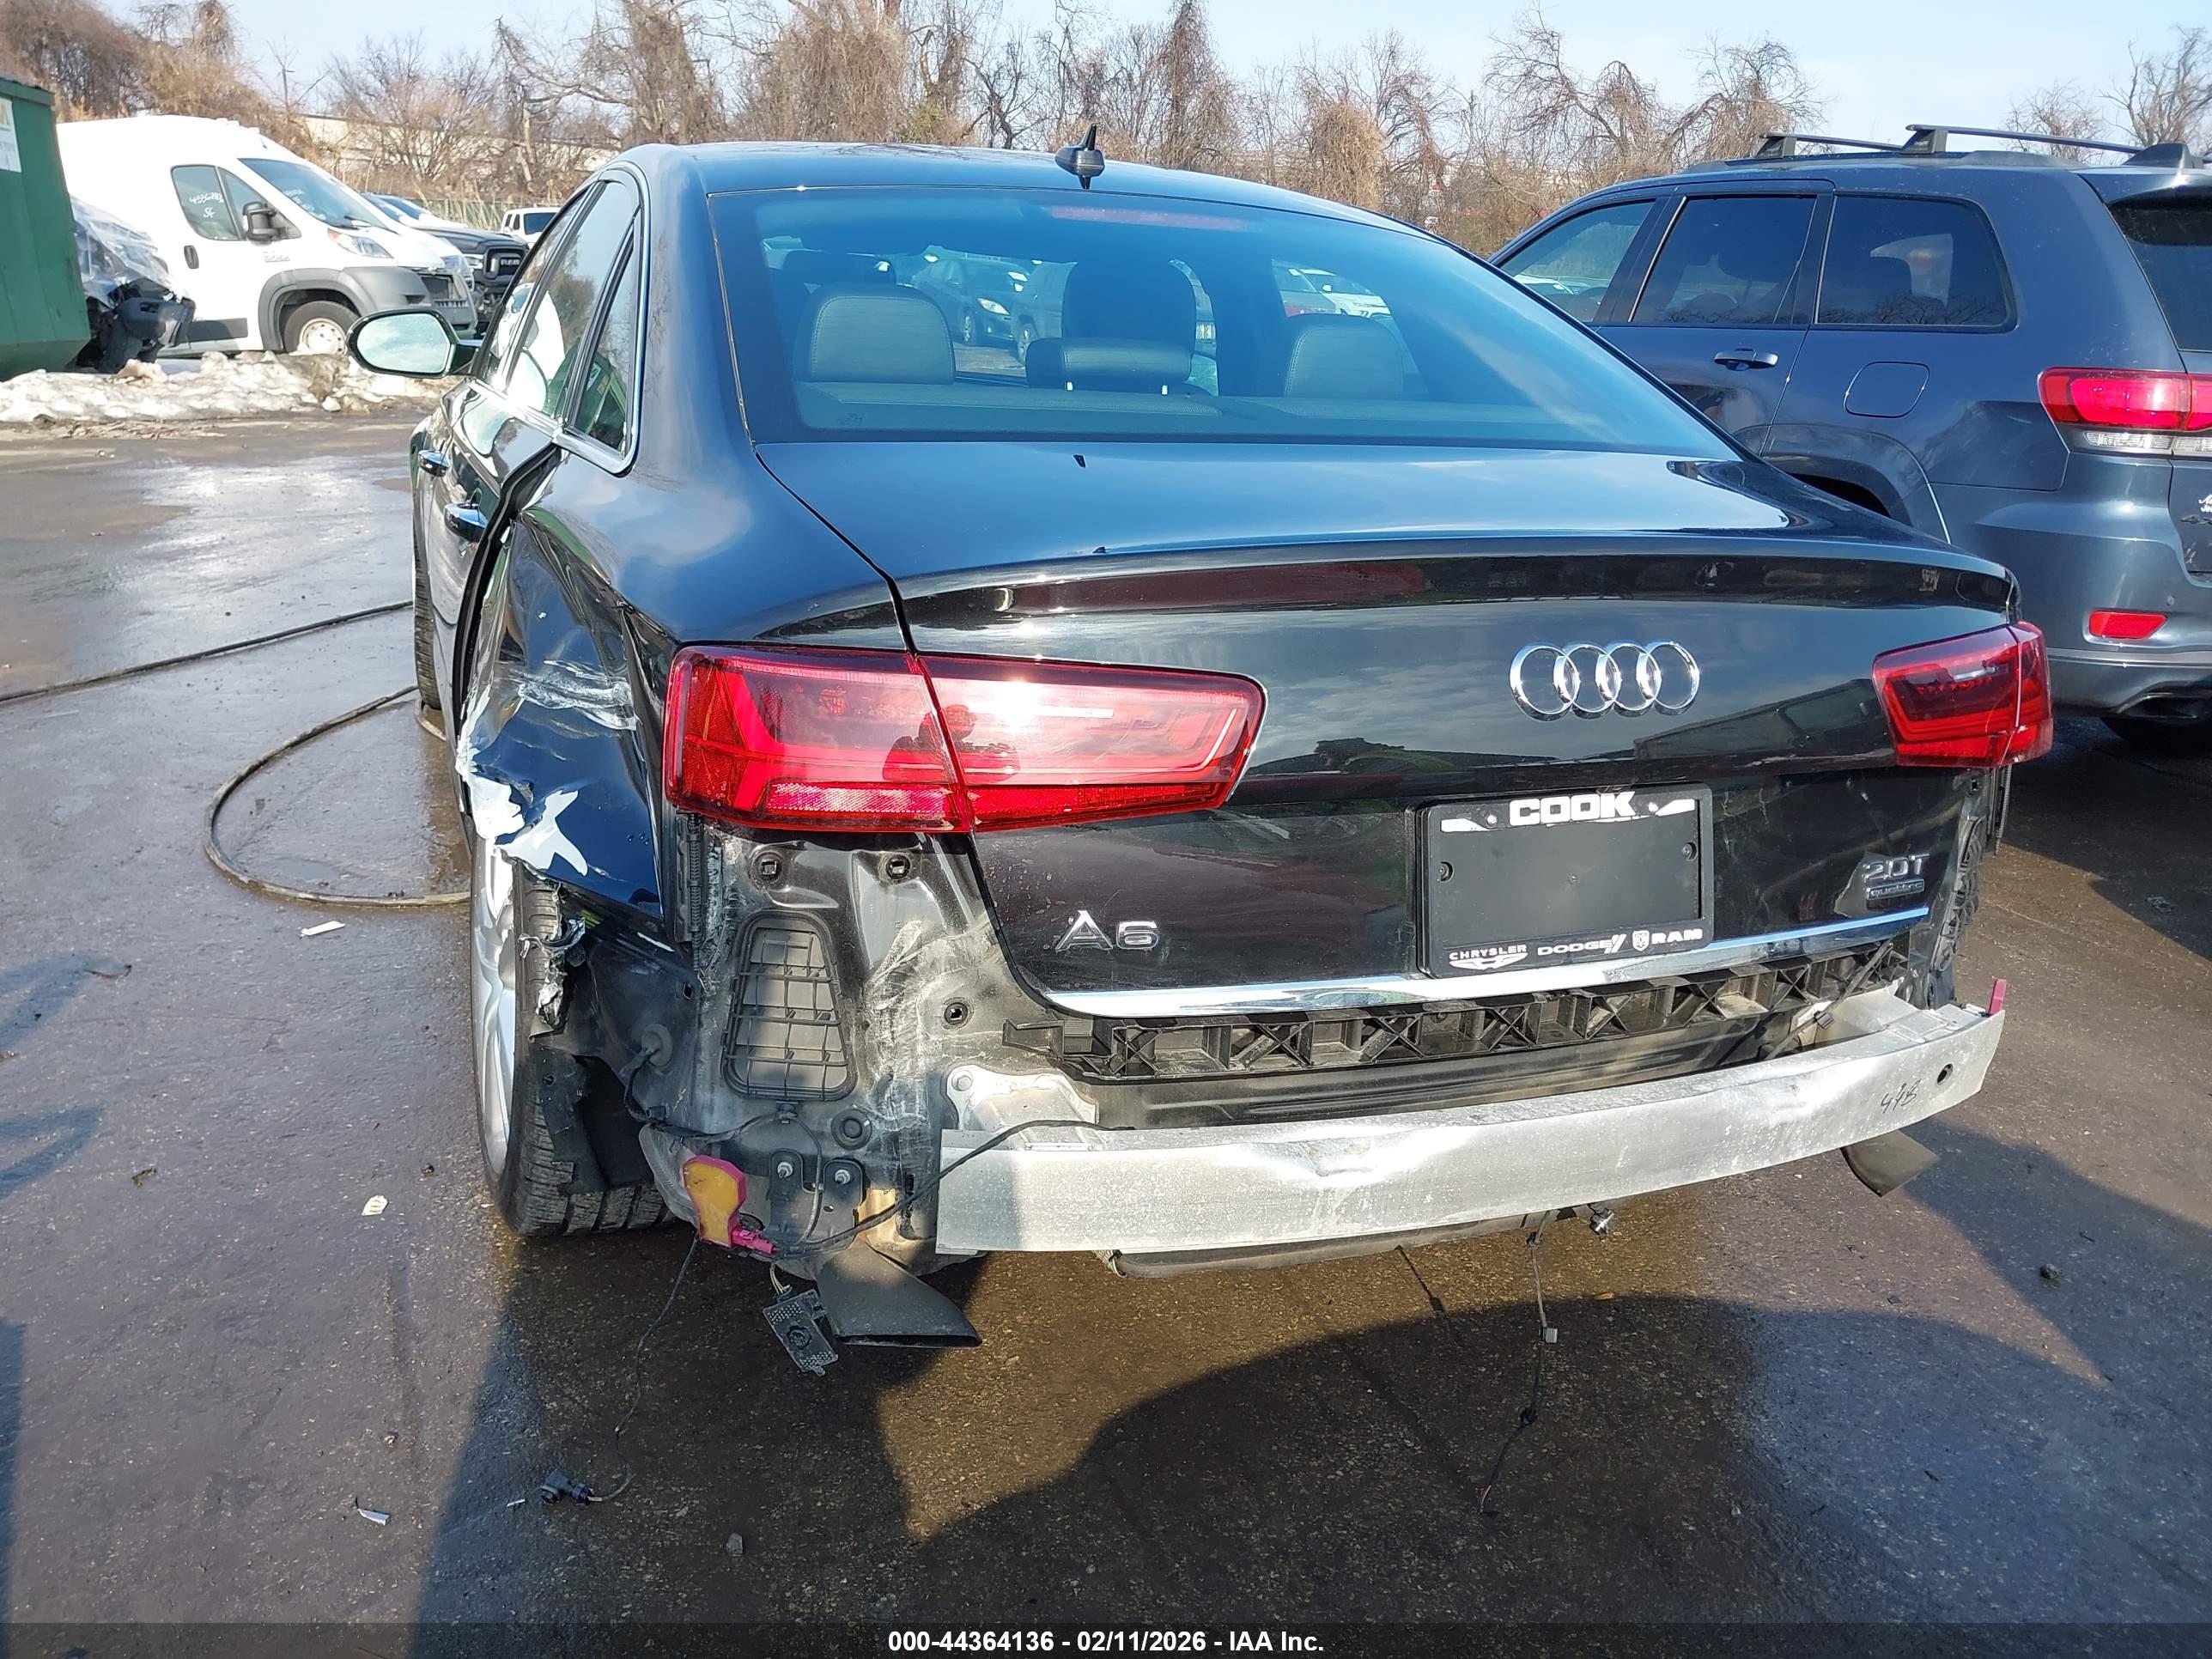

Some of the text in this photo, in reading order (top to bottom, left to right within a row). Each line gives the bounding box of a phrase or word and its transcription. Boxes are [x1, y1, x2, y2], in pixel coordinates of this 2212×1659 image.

[1510, 791, 1636, 826] COOK
[1055, 909, 1159, 952] A6
[1449, 928, 1704, 961] CHRYSLER DODGE RAM
